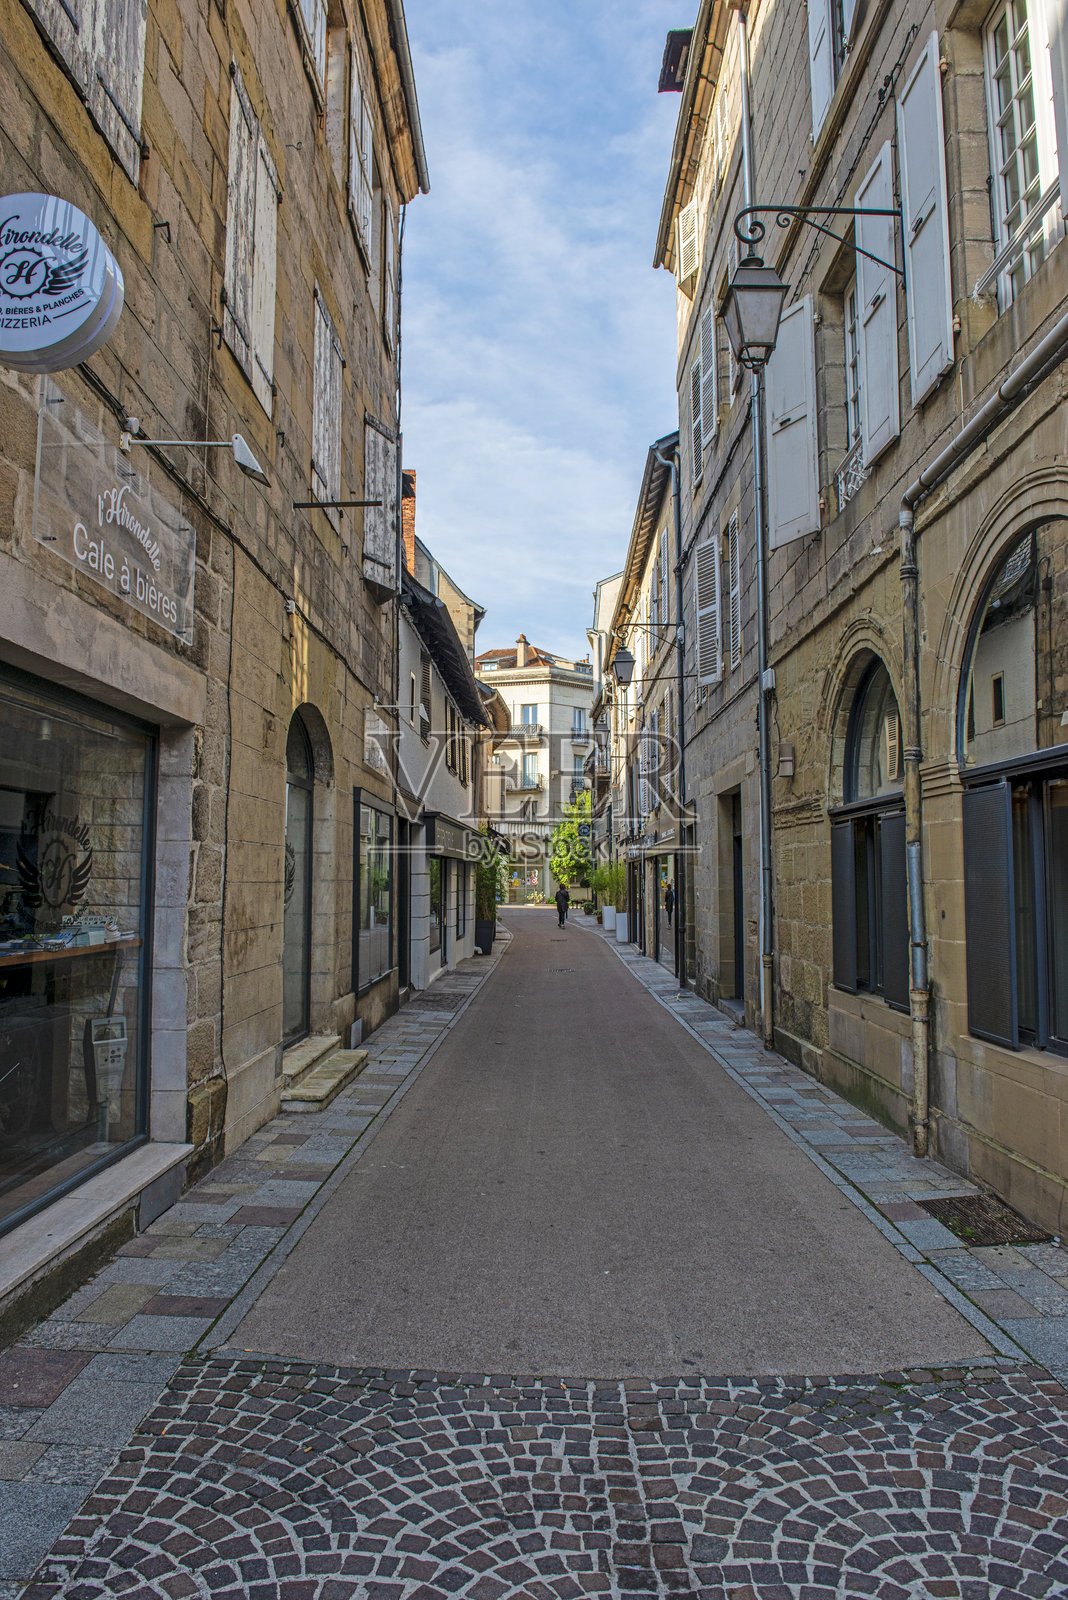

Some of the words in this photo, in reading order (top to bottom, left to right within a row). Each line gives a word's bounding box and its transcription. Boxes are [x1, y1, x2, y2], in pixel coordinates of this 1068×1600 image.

[5, 306, 34, 315] BIÈRES
[36, 305, 42, 313] &
[43, 288, 85, 311] PLANCHES
[0, 315, 52, 329] IZZERIA
[73, 522, 115, 580] Cale
[120, 557, 130, 592] à
[136, 568, 177, 624] bières
